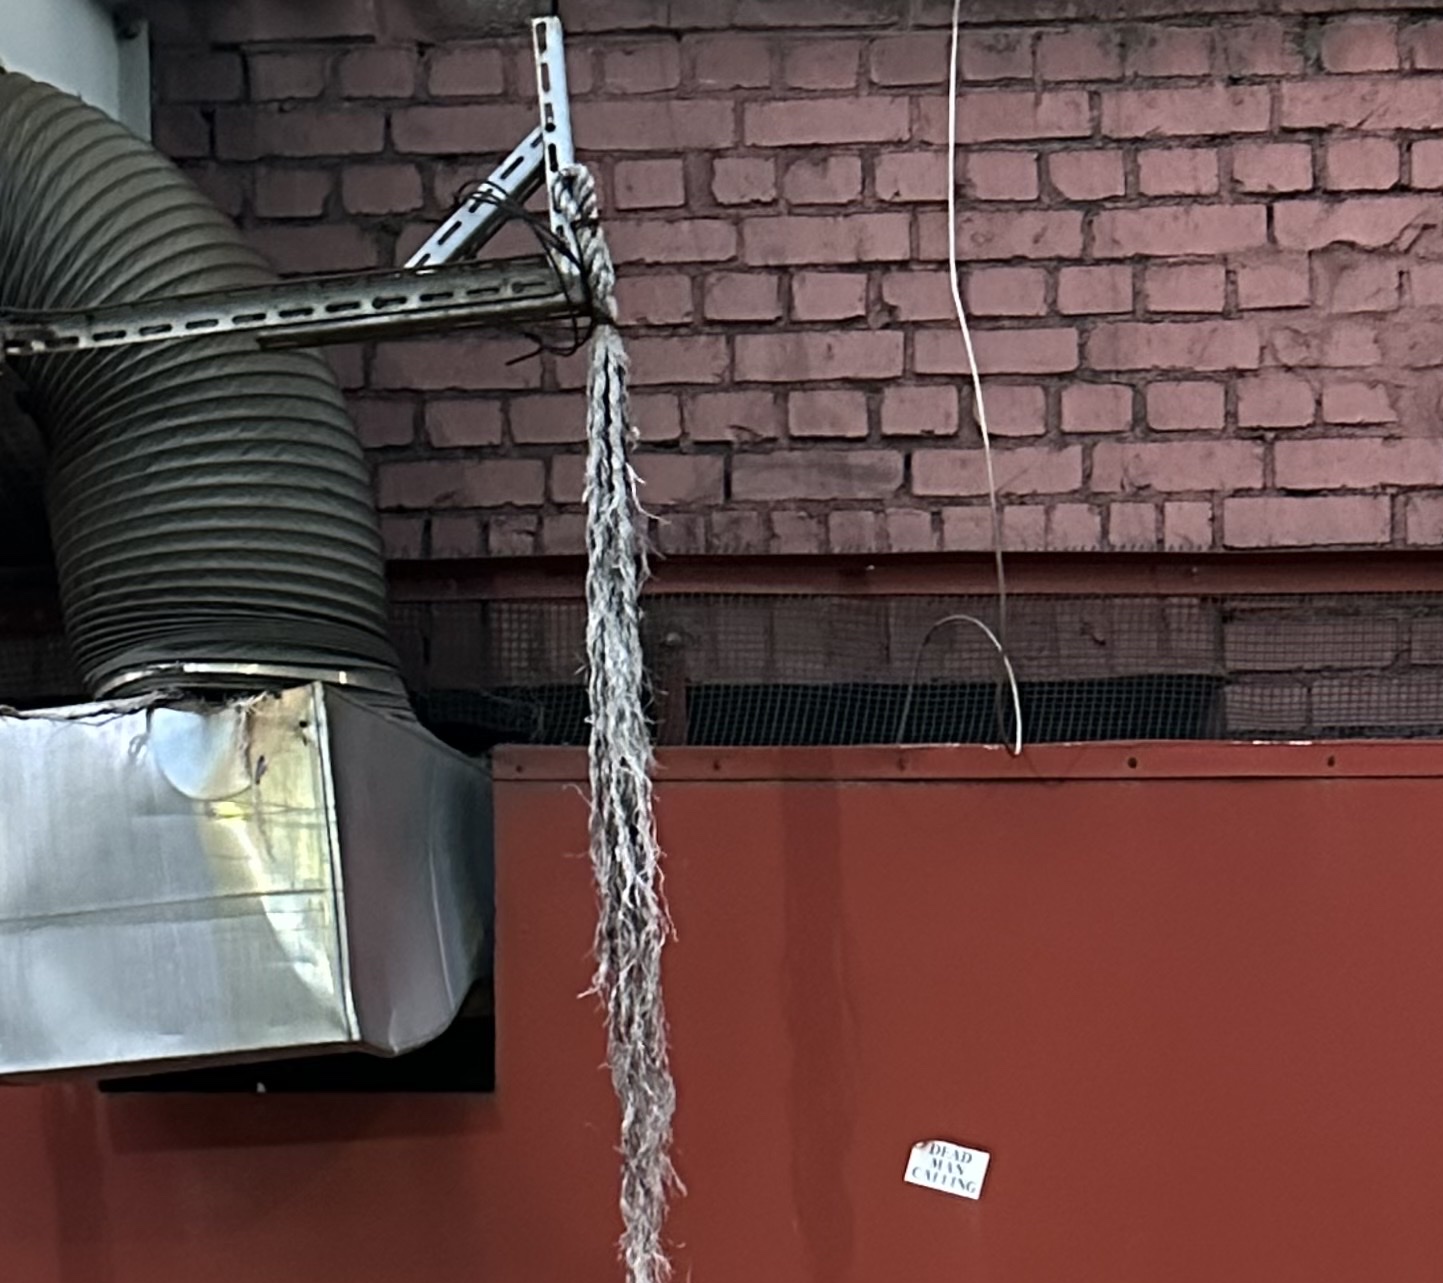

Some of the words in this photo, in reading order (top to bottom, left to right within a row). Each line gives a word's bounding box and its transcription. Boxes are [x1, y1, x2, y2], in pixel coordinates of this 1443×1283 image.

[930, 1143, 973, 1164] DEAD
[932, 1157, 964, 1176] MAN
[912, 1166, 976, 1193] CALLING
